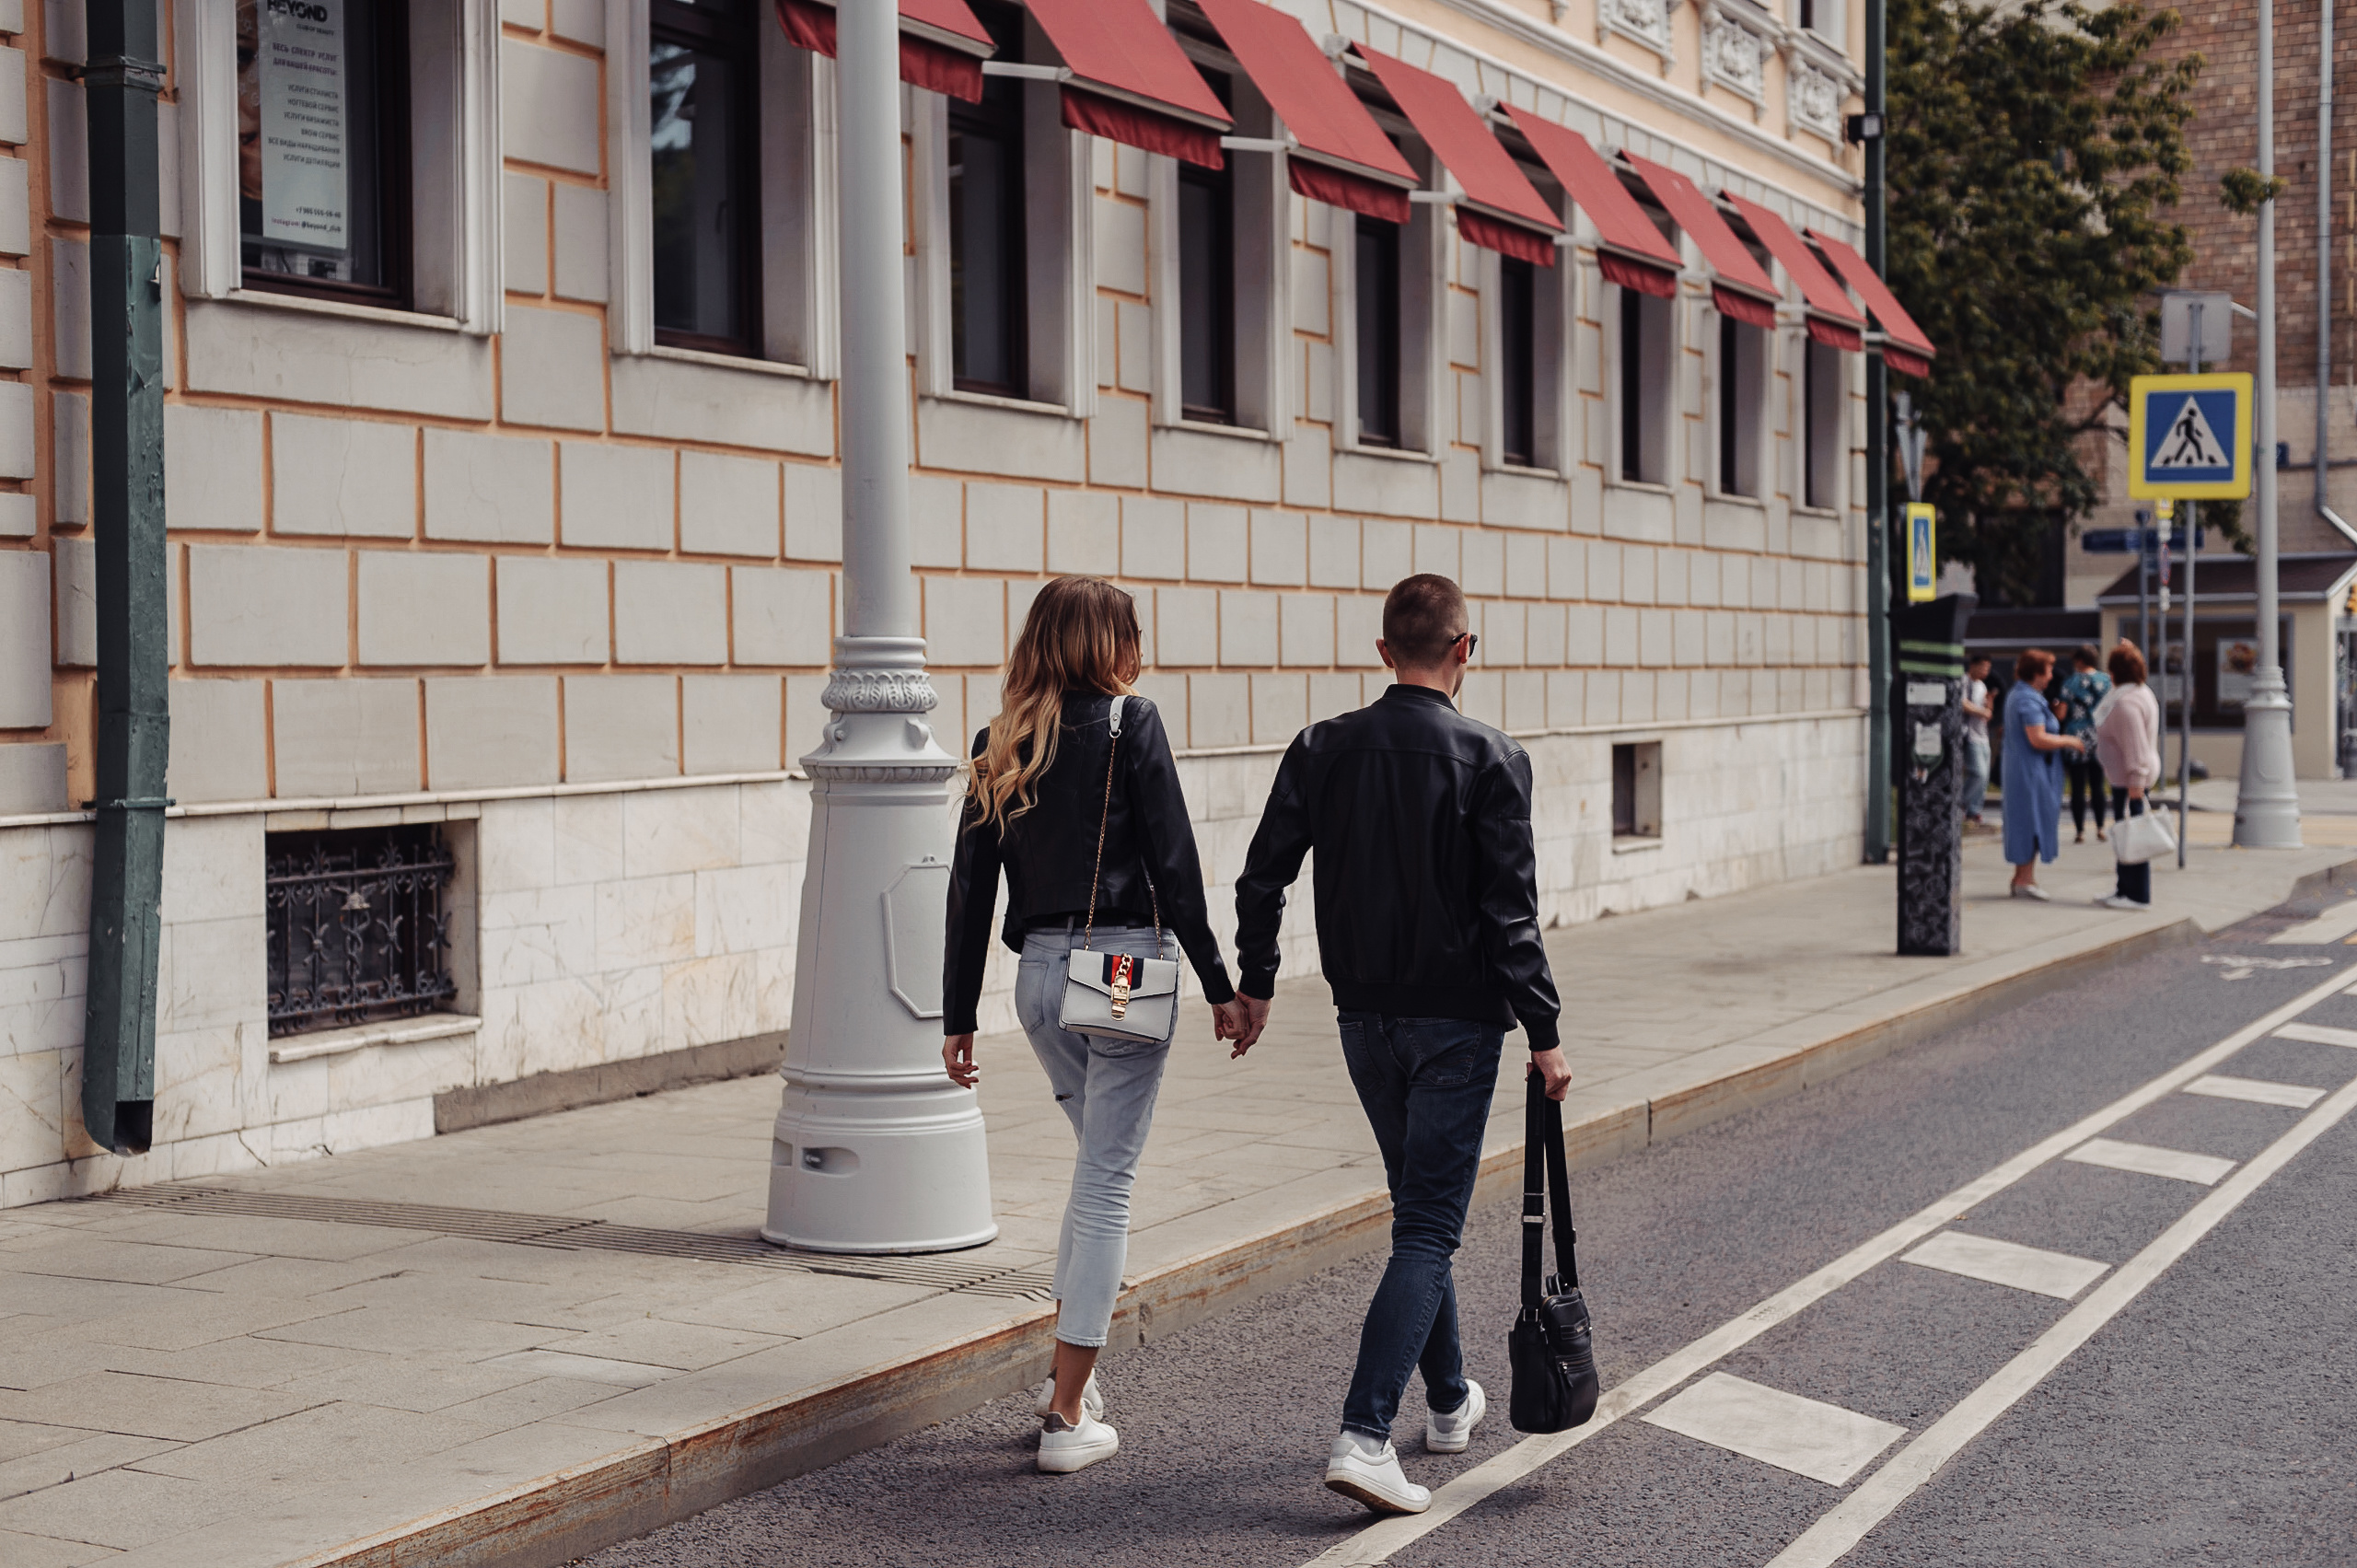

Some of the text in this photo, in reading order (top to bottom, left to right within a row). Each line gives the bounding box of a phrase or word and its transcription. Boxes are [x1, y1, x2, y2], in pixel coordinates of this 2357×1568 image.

[273, 42, 289, 52] ВЕСЬ
[291, 46, 316, 57] СПЕКТР
[273, 57, 285, 67] ДЛЯ
[287, 99, 318, 110] НОГТЕВОЙ
[284, 111, 306, 121] УСЛУГИ
[268, 136, 279, 145] ВСЕ
